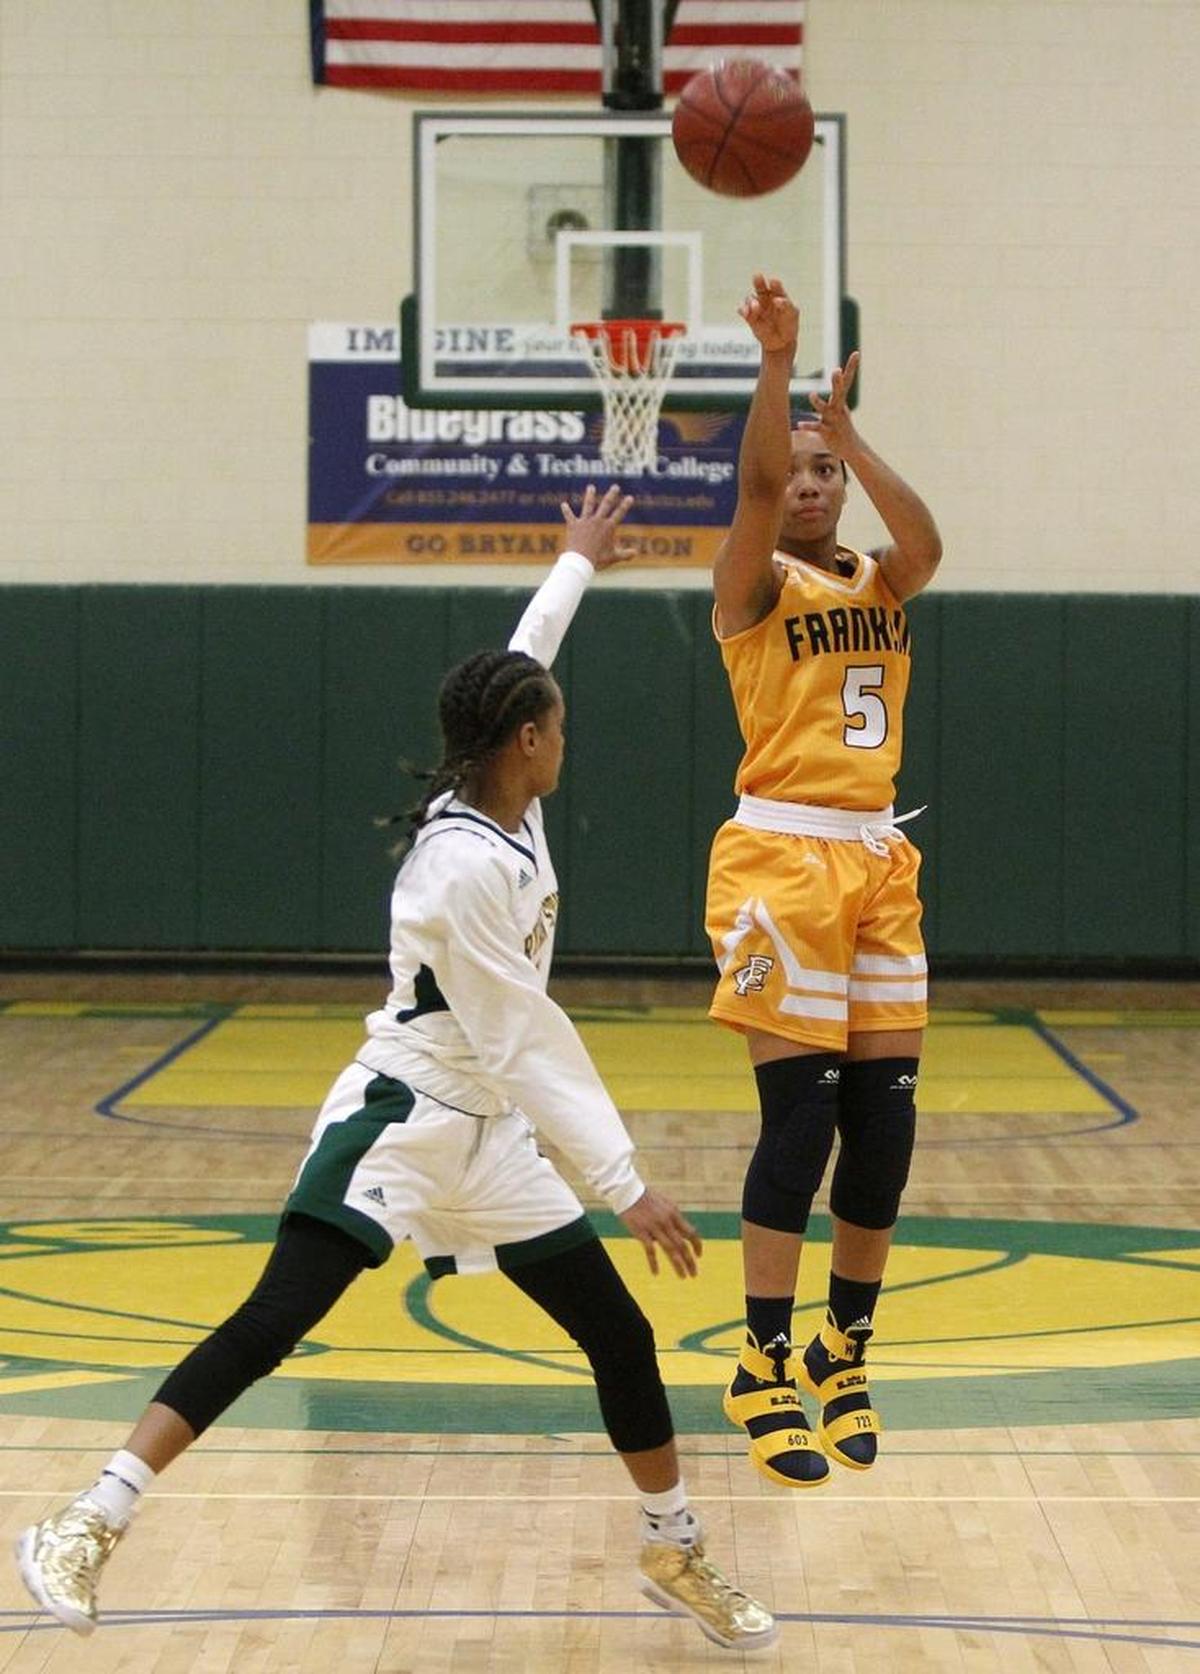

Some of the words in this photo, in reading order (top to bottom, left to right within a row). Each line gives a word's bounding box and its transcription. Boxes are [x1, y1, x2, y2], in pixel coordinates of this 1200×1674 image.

[346, 327, 516, 352] IMINE
[366, 395, 585, 446] Bluegrass
[365, 453, 500, 481] Community
[506, 453, 530, 477] &
[652, 456, 735, 483] College
[407, 534, 447, 554] GO
[459, 533, 558, 554] BRYAN
[785, 607, 910, 661] FRANK
[841, 665, 888, 748] 5
[788, 1434, 809, 1446] 603
